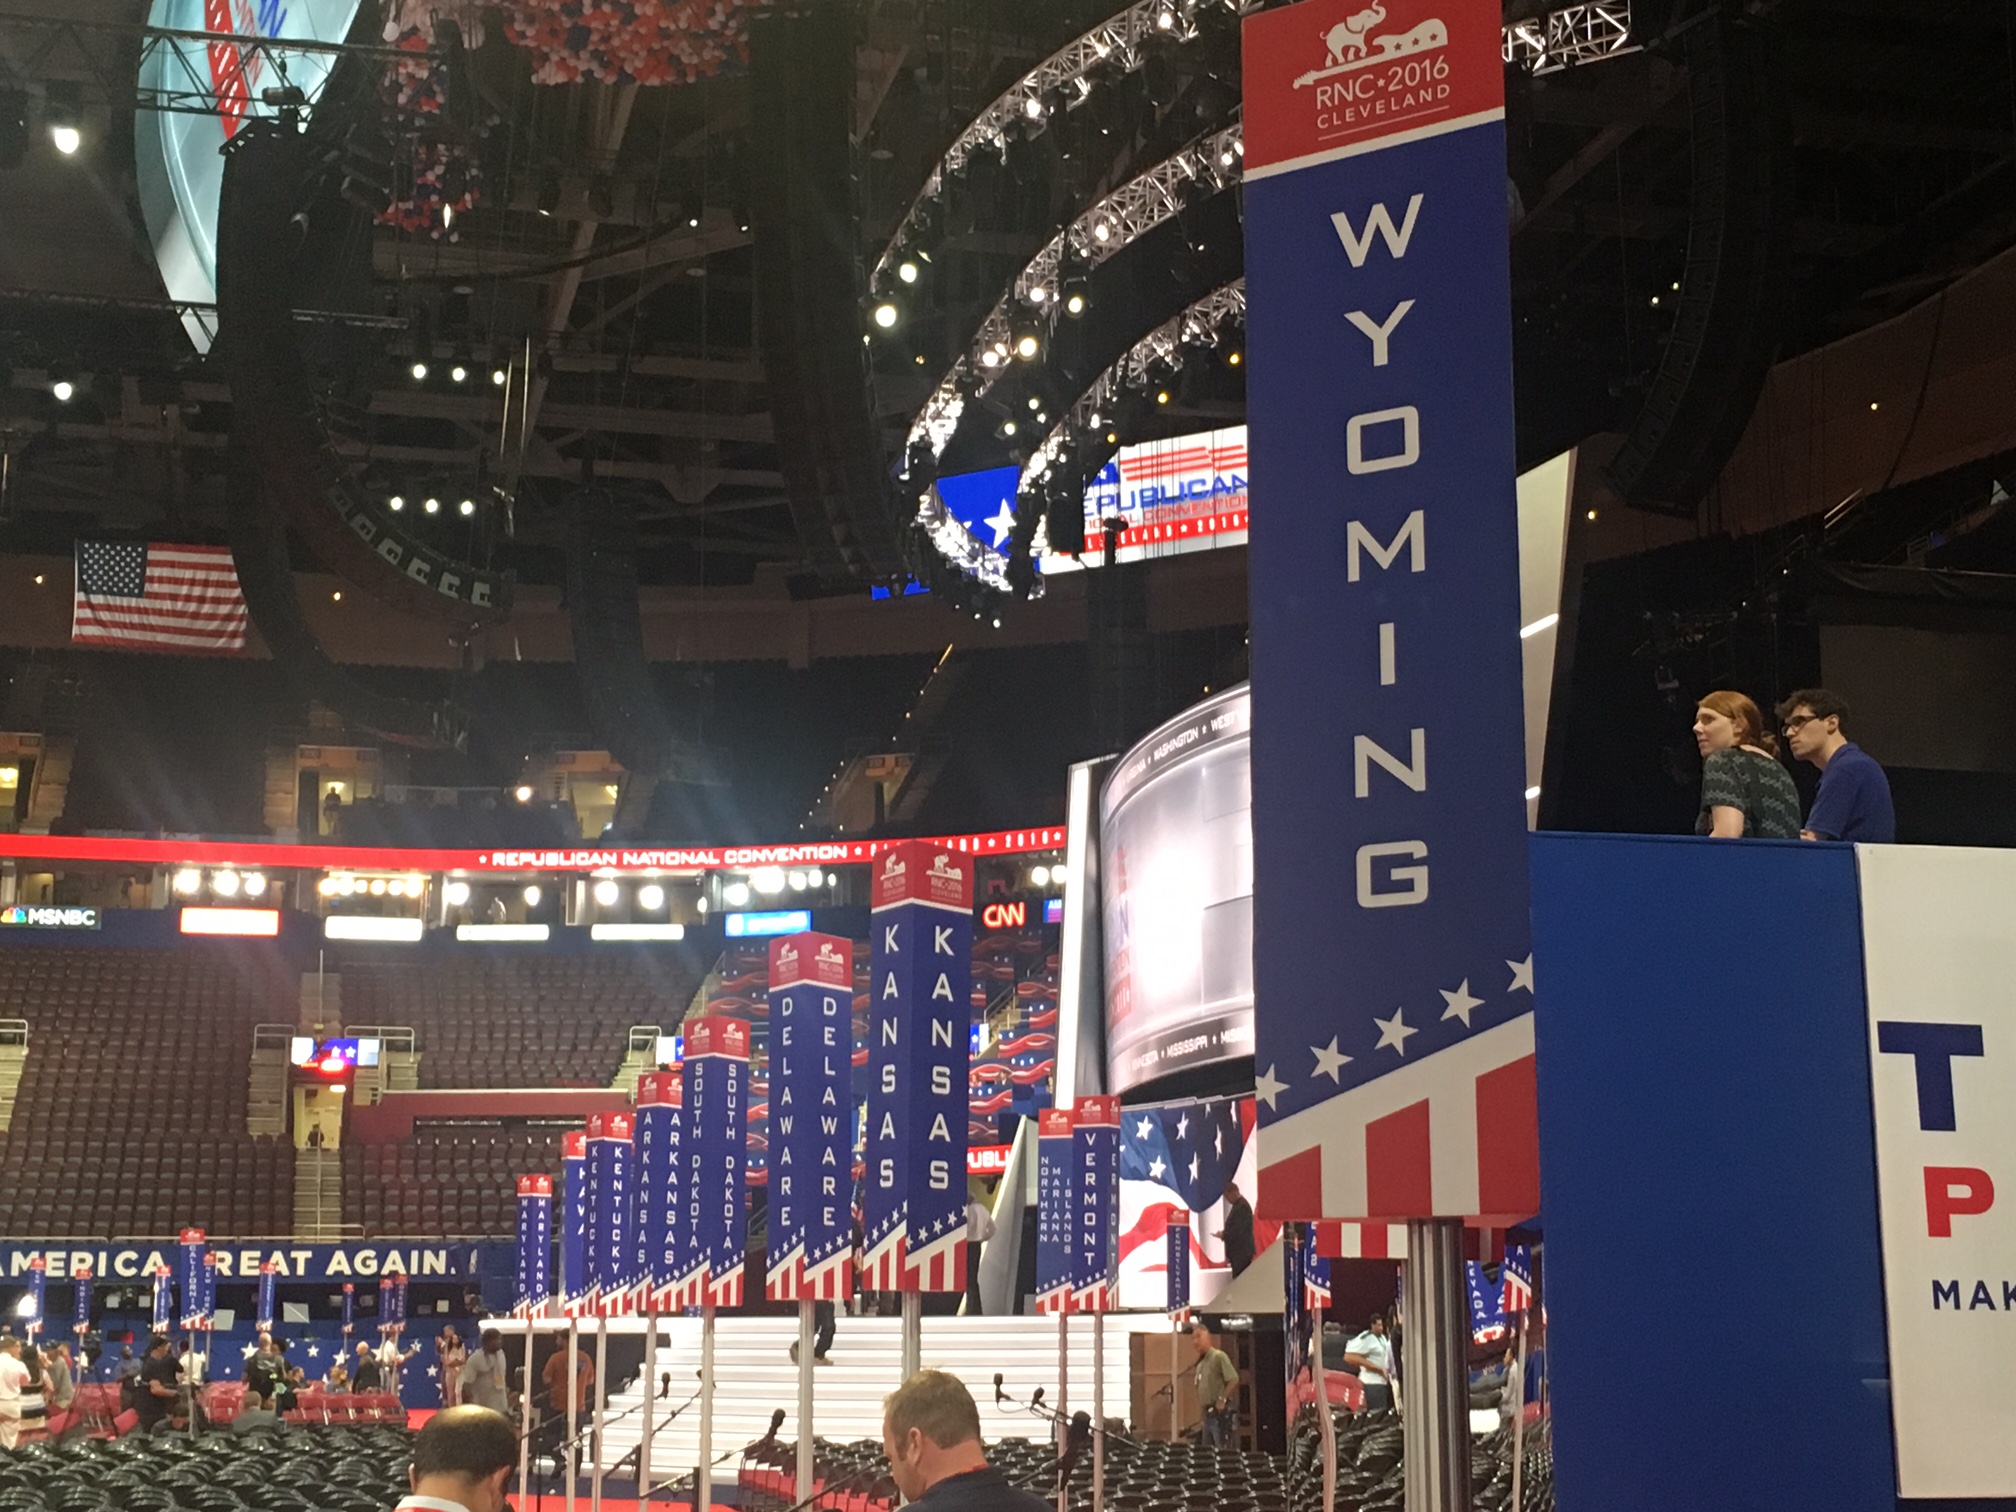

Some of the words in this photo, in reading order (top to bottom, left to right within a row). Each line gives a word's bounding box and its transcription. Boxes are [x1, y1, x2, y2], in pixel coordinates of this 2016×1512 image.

[1316, 73, 1374, 110] RNC
[1387, 55, 1450, 92] 2016
[1316, 84, 1450, 129] CLEVELAND
[1083, 474, 1248, 517] EPUBLICAN
[1330, 193, 1429, 909] WYOMING
[1153, 727, 1199, 762] WASHINGTON
[492, 851, 617, 866] REPUBLICAN
[622, 849, 720, 865] NATIONAL
[724, 845, 847, 864] CONVENTION
[28, 908, 96, 926] MSNBC
[982, 901, 1026, 928] CNN
[879, 923, 899, 1189] KANSAS
[929, 925, 955, 1190] KANSAS
[1876, 1021, 1984, 1132] T
[693, 1063, 703, 1139] SOUTH
[726, 1063, 737, 1140] SOUTH
[780, 996, 793, 1226] DELAWARE
[820, 996, 838, 1226] DELAWARE
[587, 1146, 598, 1273] KENTUCKY
[611, 1147, 623, 1275] KENTUCKY
[637, 1111, 652, 1263] ARKANSAS
[664, 1112, 681, 1264] ARKANSAS
[689, 1155, 701, 1249] DAKOTA
[723, 1156, 735, 1250] DAKOTA
[1040, 1156, 1049, 1243] NORTHERN
[1051, 1167, 1061, 1243] MARIANA
[1063, 1178, 1072, 1254] ISLANDS
[1084, 1132, 1096, 1266] VERMONT
[1923, 1166, 1996, 1238] P
[0, 1250, 167, 1277] MERICA
[215, 1250, 313, 1276] REAT
[325, 1249, 457, 1276] AGAIN.
[189, 1245, 197, 1310] CALIFORNIA
[519, 1198, 528, 1293] MARYLAND
[536, 1198, 546, 1293] MARYLAND
[1467, 1260, 1488, 1319] NEVADA
